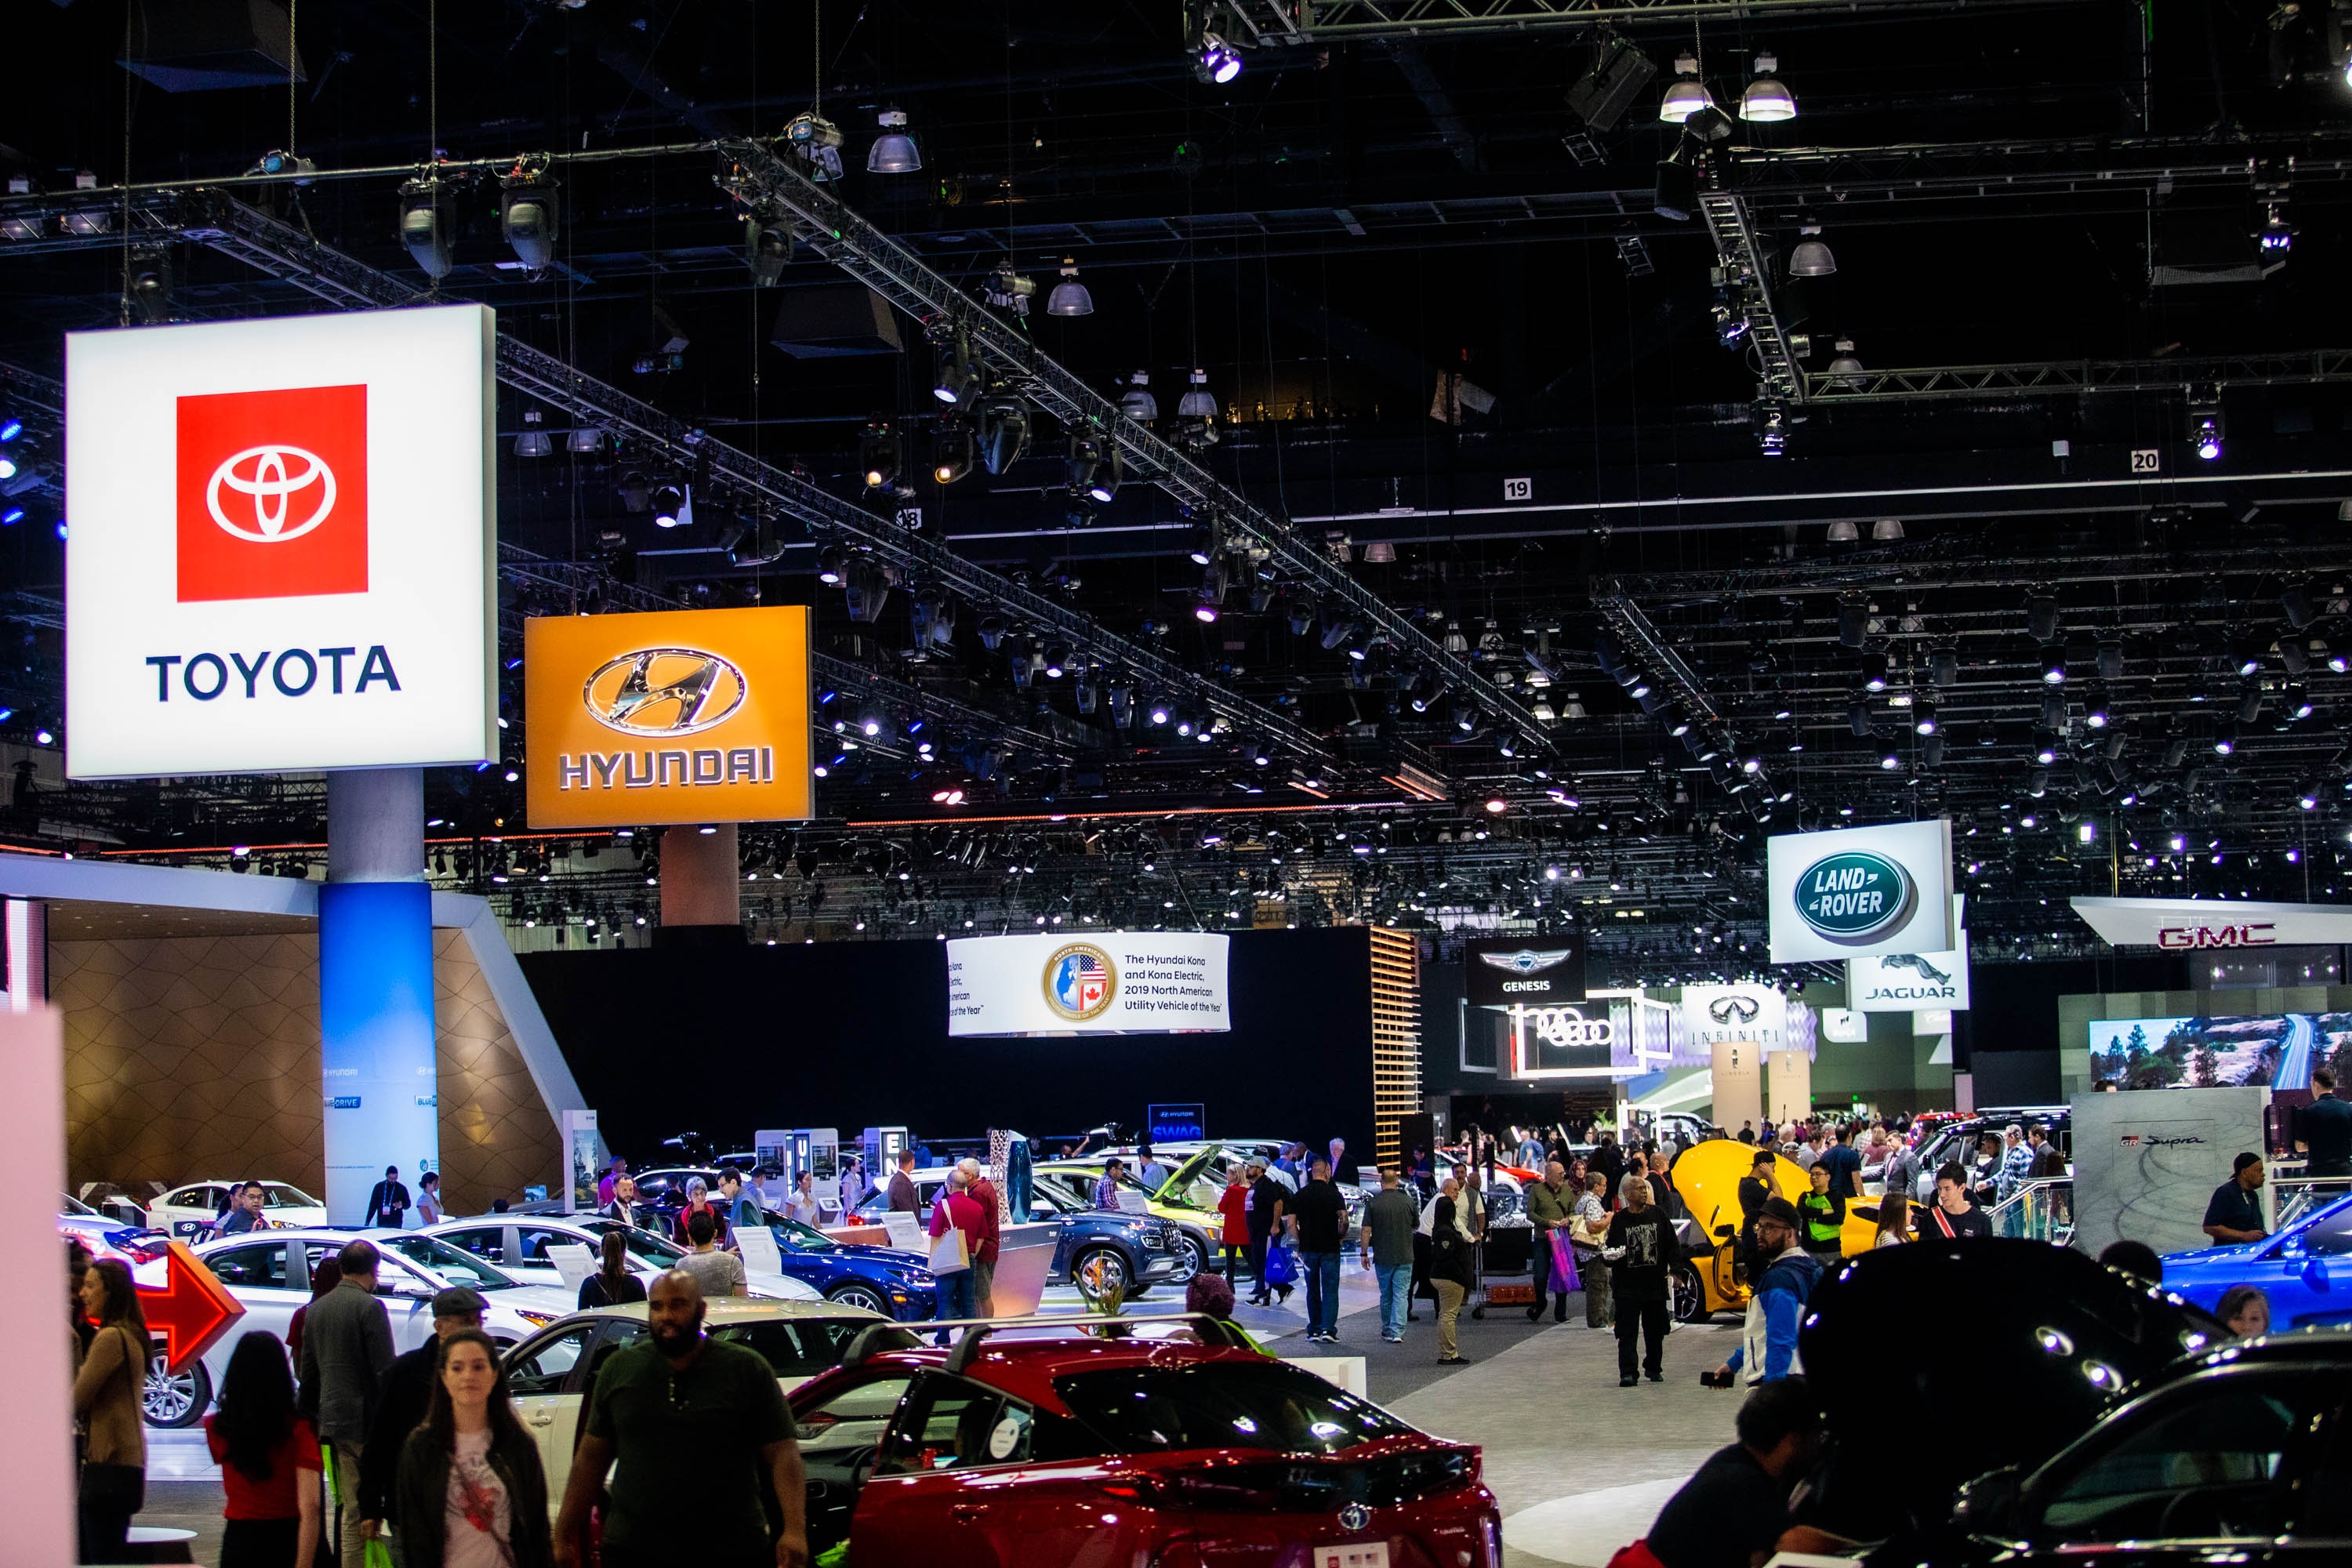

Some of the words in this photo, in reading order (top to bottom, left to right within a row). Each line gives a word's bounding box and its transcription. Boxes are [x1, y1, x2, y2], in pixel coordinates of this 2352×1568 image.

[2133, 454, 2157, 470] 20
[1507, 481, 1528, 497] 19
[146, 644, 401, 702] TOYOTA
[560, 746, 773, 790] HYUNDAI
[1815, 867, 1864, 892] LAND
[1820, 891, 1883, 917] ROVER
[2158, 924, 2276, 949] GMC
[1125, 955, 1145, 964] The
[1147, 955, 1185, 966] Hyundai
[1187, 956, 1206, 966] Kona
[1125, 970, 1145, 979] and
[1148, 970, 1172, 979] Kona
[1174, 971, 1205, 982] Electric,
[1125, 985, 1149, 995] 2019
[1152, 985, 1178, 995] North
[1179, 986, 1213, 997] American
[1502, 980, 1551, 993] GENESIS
[1865, 987, 1956, 1000] JAGUAR
[1125, 1000, 1156, 1011] Utility
[1157, 1000, 1189, 1011] Vehicle
[1190, 1001, 1198, 1011] of
[1199, 1002, 1210, 1011] the
[1692, 1029, 1779, 1046] INFINITI
[1152, 1126, 1202, 1137] SWAG
[2141, 1135, 2208, 1150] Supra
